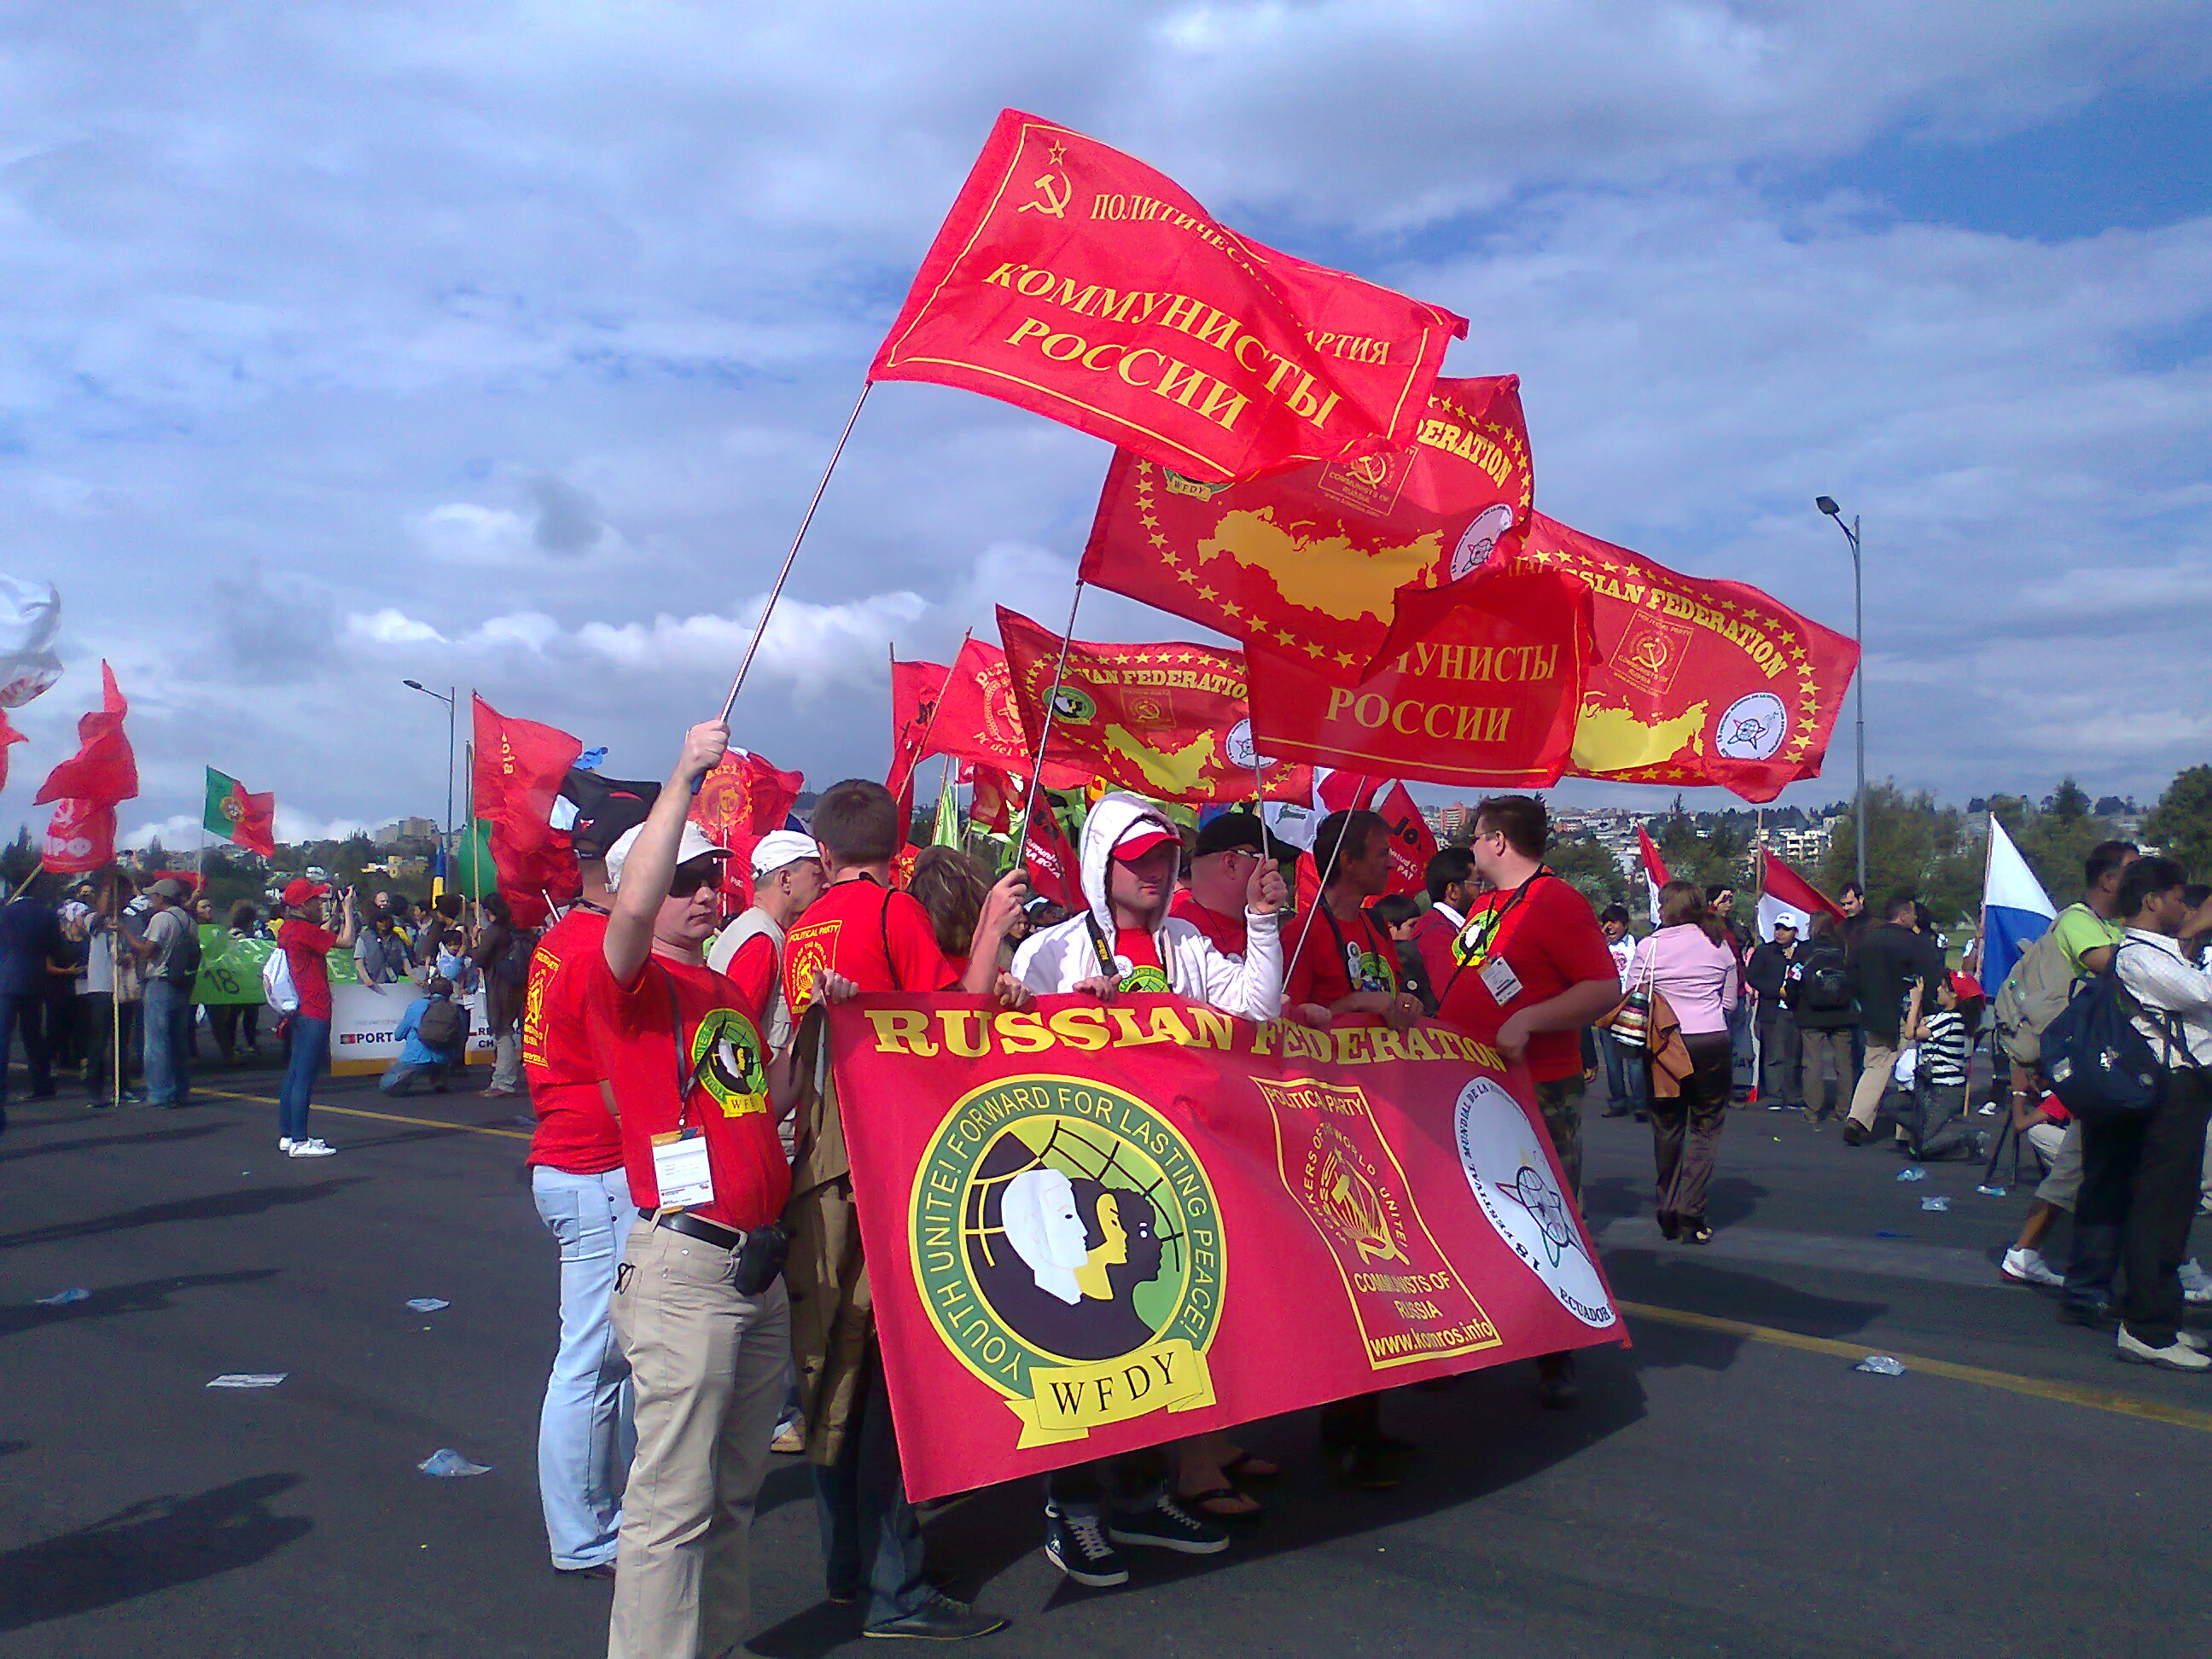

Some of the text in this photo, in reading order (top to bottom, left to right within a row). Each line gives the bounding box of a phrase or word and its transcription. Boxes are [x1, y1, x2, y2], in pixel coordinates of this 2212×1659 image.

[1090, 193, 1393, 365] ПОЛИТИЧЕС АРТИЯ
[982, 261, 1342, 429] КОММУНИСТЫ
[1004, 317, 1252, 432] РОССИИ
[1417, 418, 1514, 488] ERATION
[1566, 568, 1646, 604] SIAN
[1645, 588, 1789, 680] FEDERATION
[1121, 670, 1249, 703] FEDERATIO
[1394, 642, 1560, 683] УНИСТЫ
[1325, 685, 1513, 742] РОССИИ
[203, 968, 241, 995] 18
[356, 1030, 408, 1045] PORT
[864, 1006, 1507, 1072] RUSSIAN FEDERATION
[1325, 1094, 1365, 1116] PARTY
[1467, 1163, 1516, 1240] FESTIVAL
[925, 1086, 1214, 1381] YOUTH UNITE! FORWARD FOR LASTING PEACE!
[1514, 1242, 1541, 1272] 18
[1353, 1271, 1451, 1295] COMMUNISTS OF
[1393, 1300, 1444, 1320] RUSSIA
[1369, 1318, 1493, 1358] www.komros.info
[1049, 1351, 1176, 1417] WFDY
